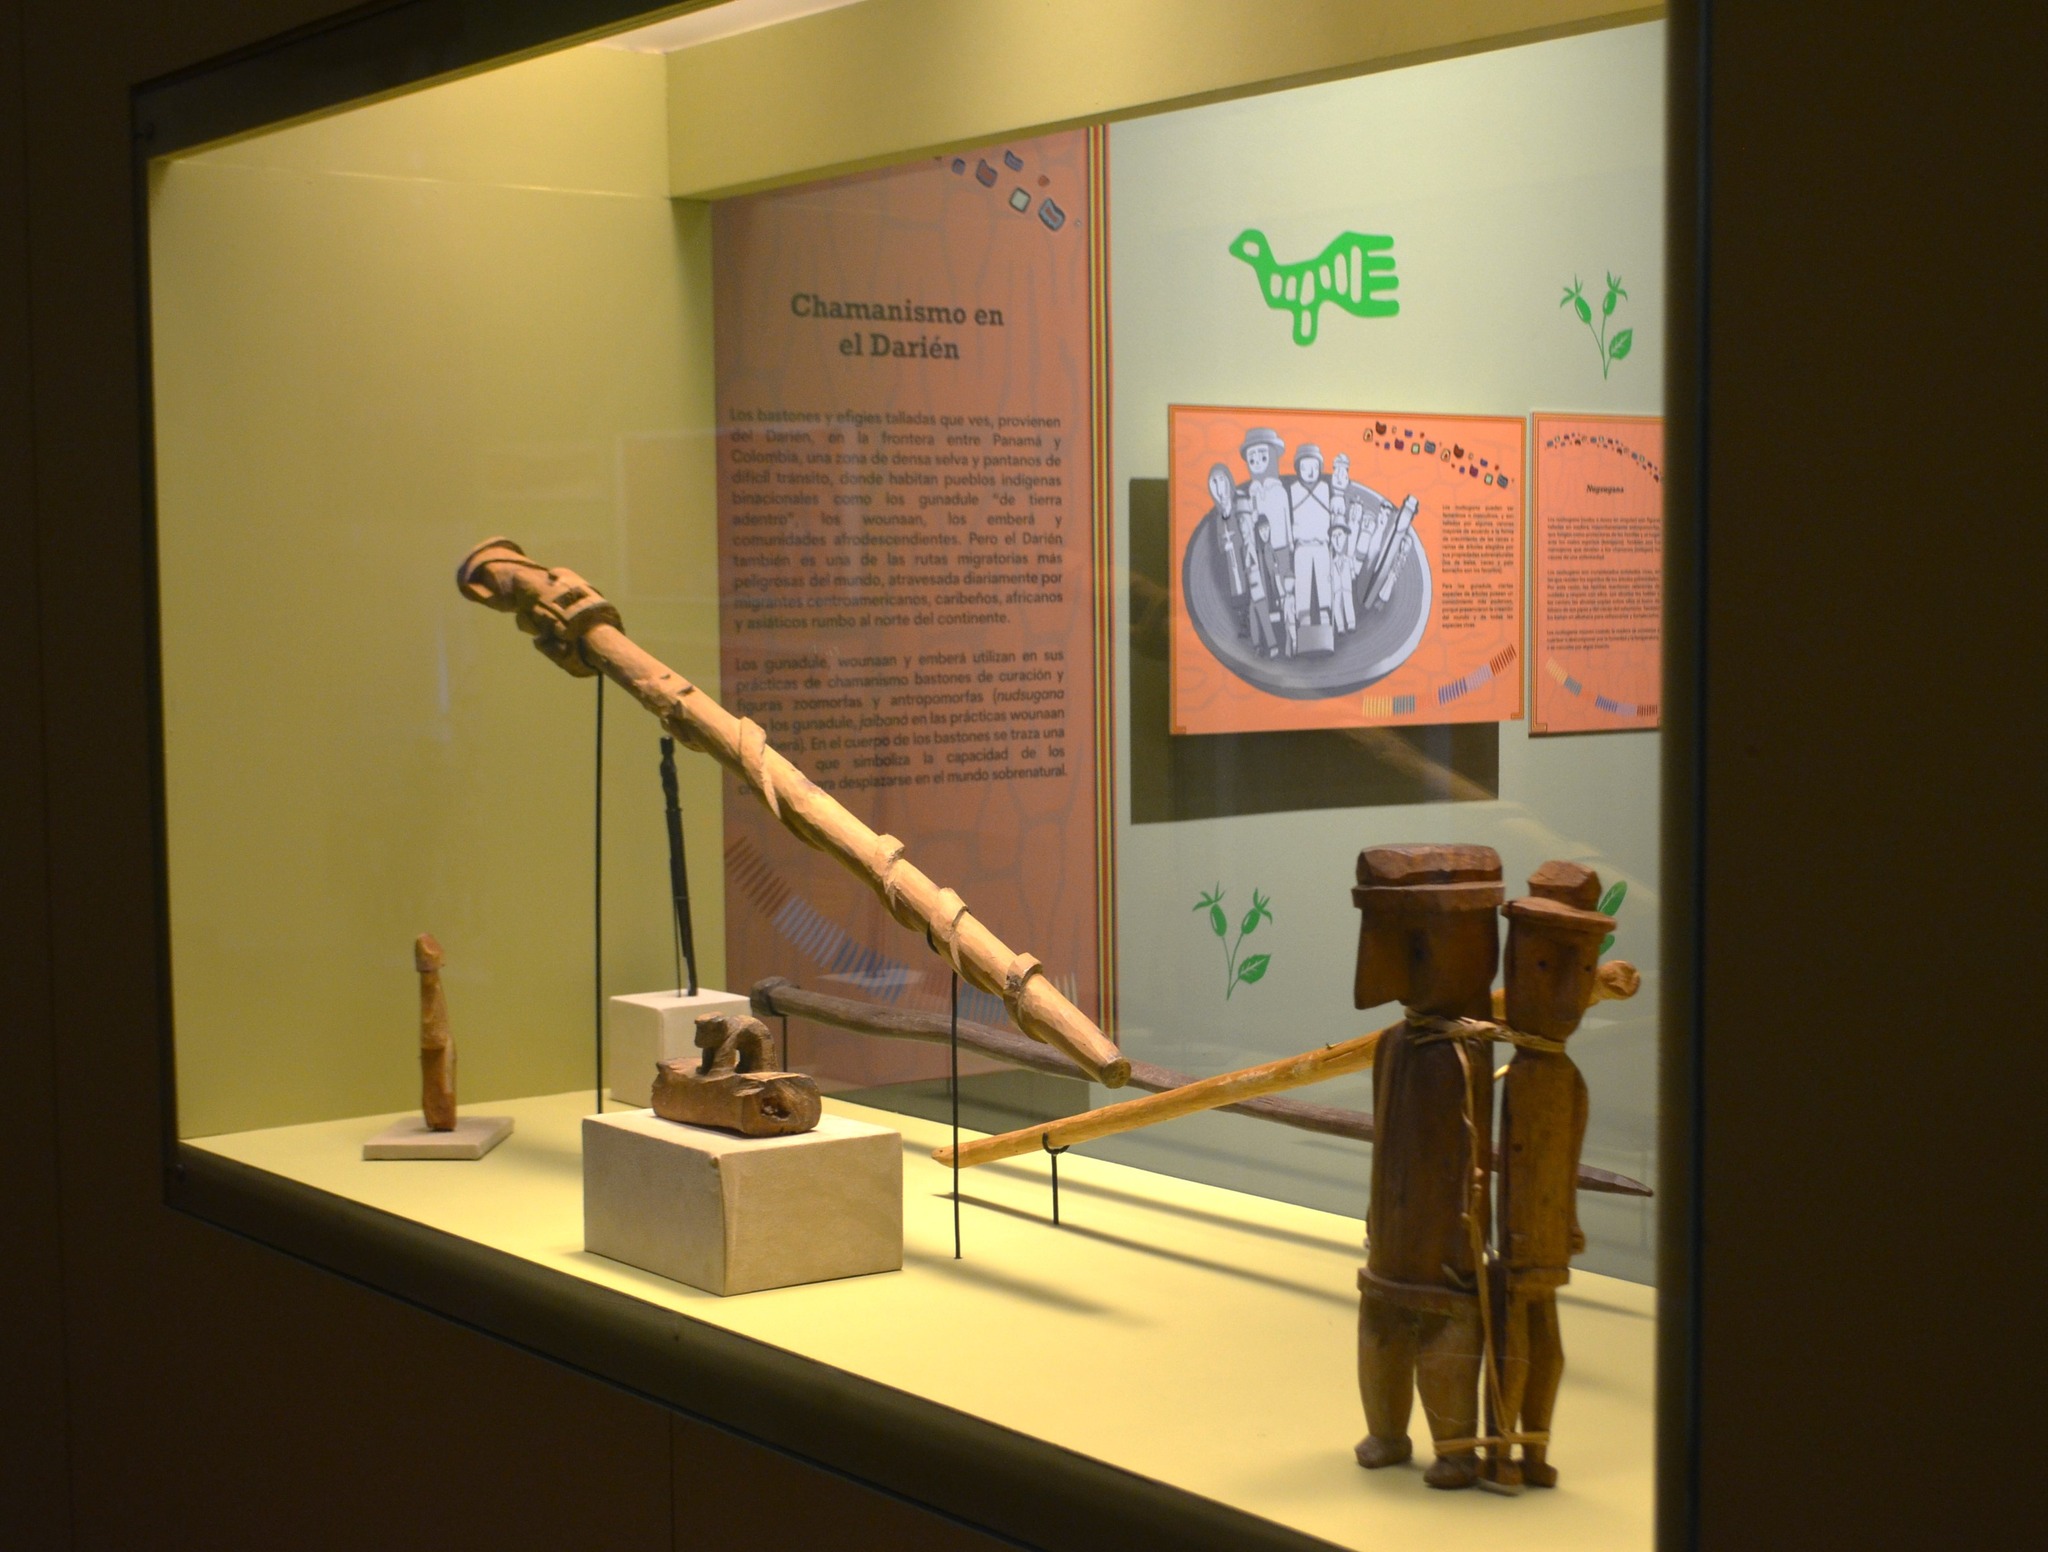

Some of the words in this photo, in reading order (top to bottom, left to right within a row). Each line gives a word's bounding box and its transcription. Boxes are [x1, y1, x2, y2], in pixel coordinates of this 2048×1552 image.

[791, 294, 967, 324] Chamanismo
[974, 308, 1005, 327] en
[839, 332, 863, 357] el
[870, 332, 960, 360] Darién
[729, 408, 754, 422] Los
[756, 409, 821, 423] bastones
[825, 413, 834, 428] y
[836, 410, 881, 429] efigies
[885, 411, 936, 425] talladas
[939, 415, 964, 430] que
[967, 416, 994, 430] ves,
[997, 413, 1061, 431] provienen
[729, 429, 753, 443] del
[827, 434, 845, 444] en
[857, 431, 869, 445] la
[881, 431, 934, 445] frontera
[946, 432, 981, 446] entre
[992, 433, 1041, 447] Panamá
[1052, 437, 1061, 451] y
[806, 454, 832, 465] una
[835, 454, 867, 465] zona
[870, 451, 888, 465] de
[891, 452, 931, 465] densa
[934, 452, 969, 466] selva
[971, 456, 980, 470] y
[983, 453, 1042, 470] pantanos
[1045, 453, 1061, 466] de
[839, 472, 883, 485] donde
[888, 472, 938, 485] habitan
[943, 472, 996, 490] pueblos
[1000, 473, 1061, 490] indígenas
[731, 492, 819, 505] binacionales
[832, 495, 872, 505] como
[884, 492, 905, 505] los
[918, 492, 979, 509] gunadule
[1028, 492, 1062, 505] tierra
[820, 512, 841, 526] los
[861, 515, 927, 530] wounaan,
[947, 512, 967, 525] los
[986, 512, 1035, 525] emberá
[1054, 515, 1062, 529] y
[732, 533, 826, 547] comunidades
[832, 532, 962, 546] afrodescendientes.
[968, 532, 998, 545] Pero
[1003, 531, 1016, 545] el
[1022, 531, 1062, 544] Darién
[732, 553, 791, 568] también
[799, 557, 816, 567] es
[825, 556, 851, 566] una
[860, 553, 878, 566] de
[886, 552, 905, 566] las
[914, 552, 948, 565] rutas
[956, 551, 1029, 569] migratorias
[1037, 551, 1063, 564] más
[733, 574, 805, 593] peligrosas
[809, 573, 830, 587] del
[833, 573, 884, 591] mundo,
[887, 571, 960, 586] atravesada
[963, 570, 1038, 584] diariamente
[1041, 573, 1063, 587] por
[934, 590, 1003, 609] caribeños,
[1005, 589, 1063, 603] africanos
[734, 619, 744, 634] y
[746, 614, 808, 629] asiáticos
[811, 613, 857, 628] rumbo
[859, 613, 871, 627] al
[874, 612, 910, 626] norte
[913, 612, 934, 625] del
[937, 610, 1011, 625] continente.
[735, 657, 758, 671] Los
[837, 656, 897, 668] wounaan
[903, 655, 912, 669] y
[917, 650, 967, 665] emberá
[971, 649, 1015, 663] utilizan
[1021, 651, 1037, 661] en
[1043, 650, 1064, 661] sus
[803, 675, 822, 689] de
[826, 672, 909, 688] chamanismo
[913, 670, 972, 685] bastones
[976, 669, 994, 683] de
[998, 667, 1051, 682] curación
[1056, 670, 1064, 683] y
[794, 694, 862, 710] zoomorfas
[872, 696, 881, 710] y
[889, 689, 984, 710] antropomorfas
[770, 717, 789, 731] los
[910, 714, 927, 725] en
[929, 710, 947, 724] las
[1009, 708, 1065, 720] wounaan
[810, 735, 828, 749] En
[830, 735, 841, 748] el
[843, 736, 890, 752] cuerpo
[892, 732, 910, 745] de
[912, 731, 931, 744] los
[933, 728, 990, 743] bastones
[993, 730, 1007, 740] se
[1010, 725, 1040, 740] traza
[1043, 727, 1065, 738] una
[815, 758, 840, 773] que
[852, 751, 910, 767] simboliza
[923, 750, 933, 764] la
[945, 746, 1008, 766] capacidad
[1020, 745, 1036, 758] de
[1047, 743, 1065, 757] los
[838, 771, 912, 792] desplazarse
[915, 773, 930, 784] en
[933, 769, 944, 783] el
[946, 767, 990, 782] mundo
